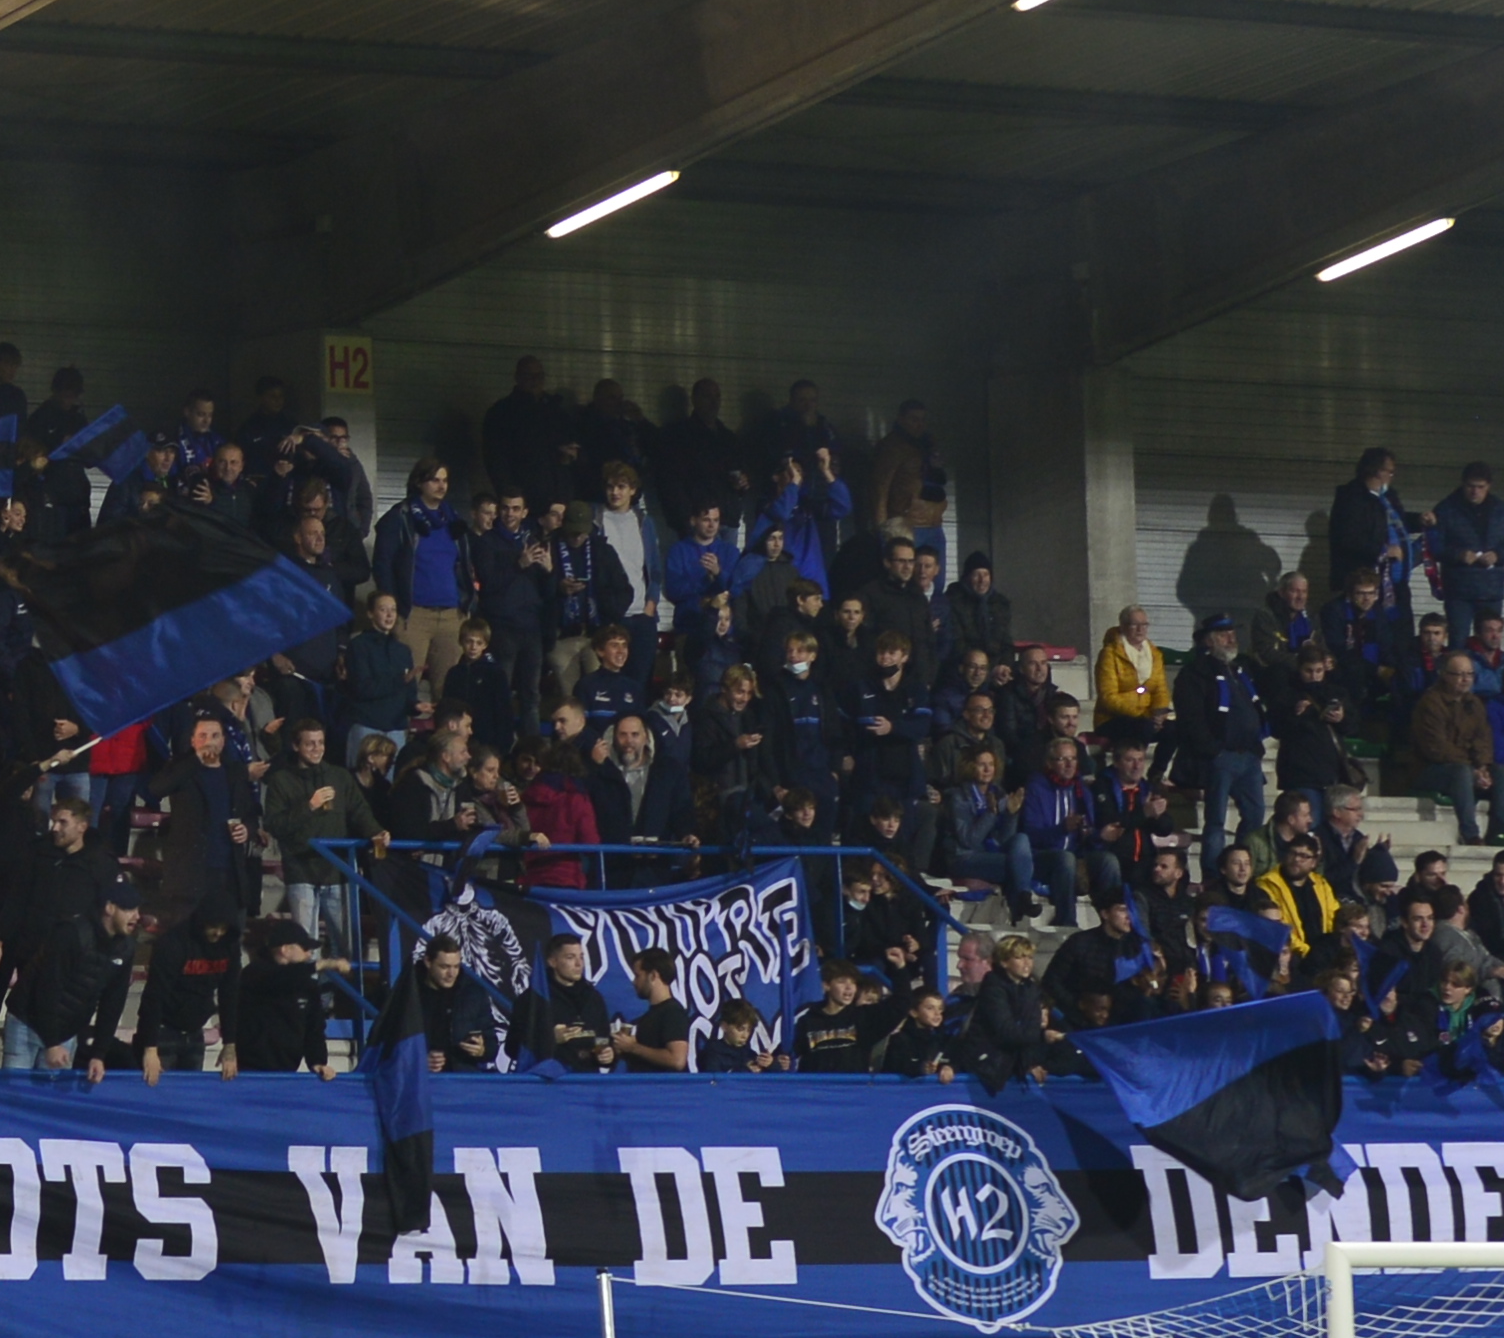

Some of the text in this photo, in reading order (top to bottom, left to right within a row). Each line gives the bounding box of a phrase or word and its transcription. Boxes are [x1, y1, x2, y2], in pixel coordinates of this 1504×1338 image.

[328, 346, 369, 390] H2
[617, 1146, 798, 1287] DE
[940, 1182, 1015, 1243] H2
